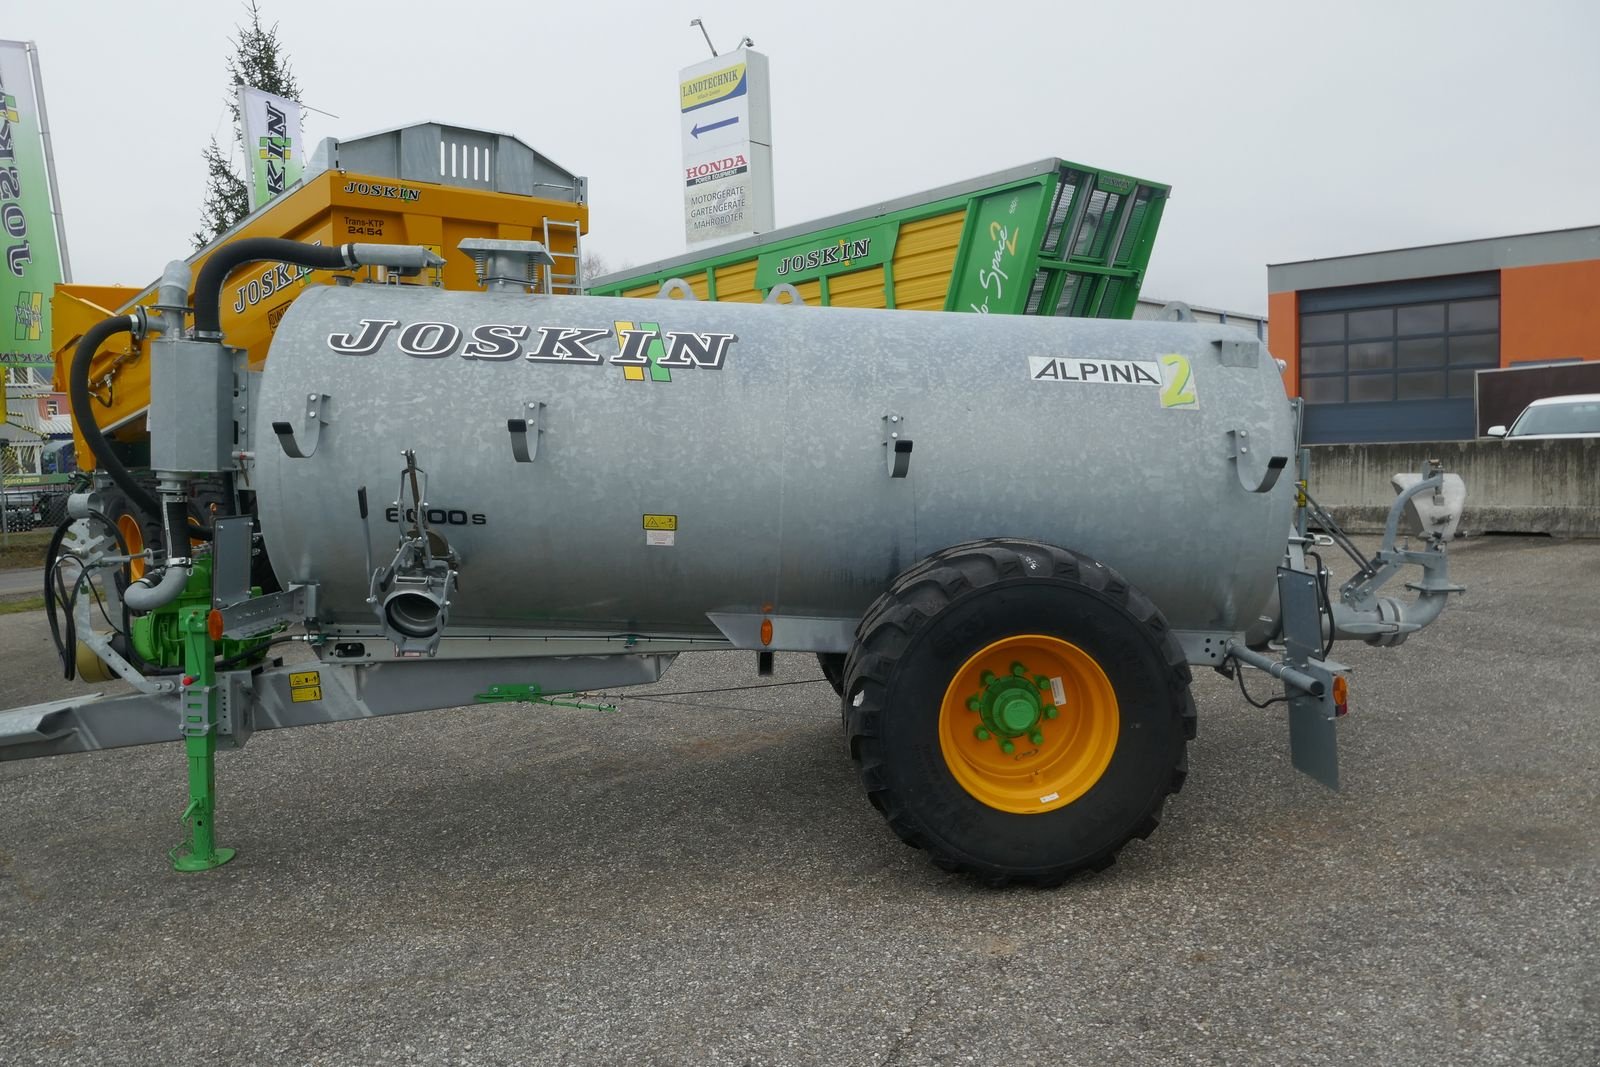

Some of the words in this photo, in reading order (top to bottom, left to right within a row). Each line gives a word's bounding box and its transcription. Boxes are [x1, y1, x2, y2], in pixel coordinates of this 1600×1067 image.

[682, 69, 738, 97] LANDTECHNIK
[686, 154, 747, 179] HONDA
[695, 176, 712, 184] POWER
[712, 169, 738, 180] EQUIPMENT
[344, 182, 421, 201] JOSKIN
[344, 216, 384, 228] Trans-KTP
[777, 238, 871, 275] JOSKIN
[234, 240, 321, 314] JOSKI
[327, 319, 739, 371] JOSKIN
[1034, 359, 1160, 384] ALPINA
[1162, 353, 1195, 407] 2
